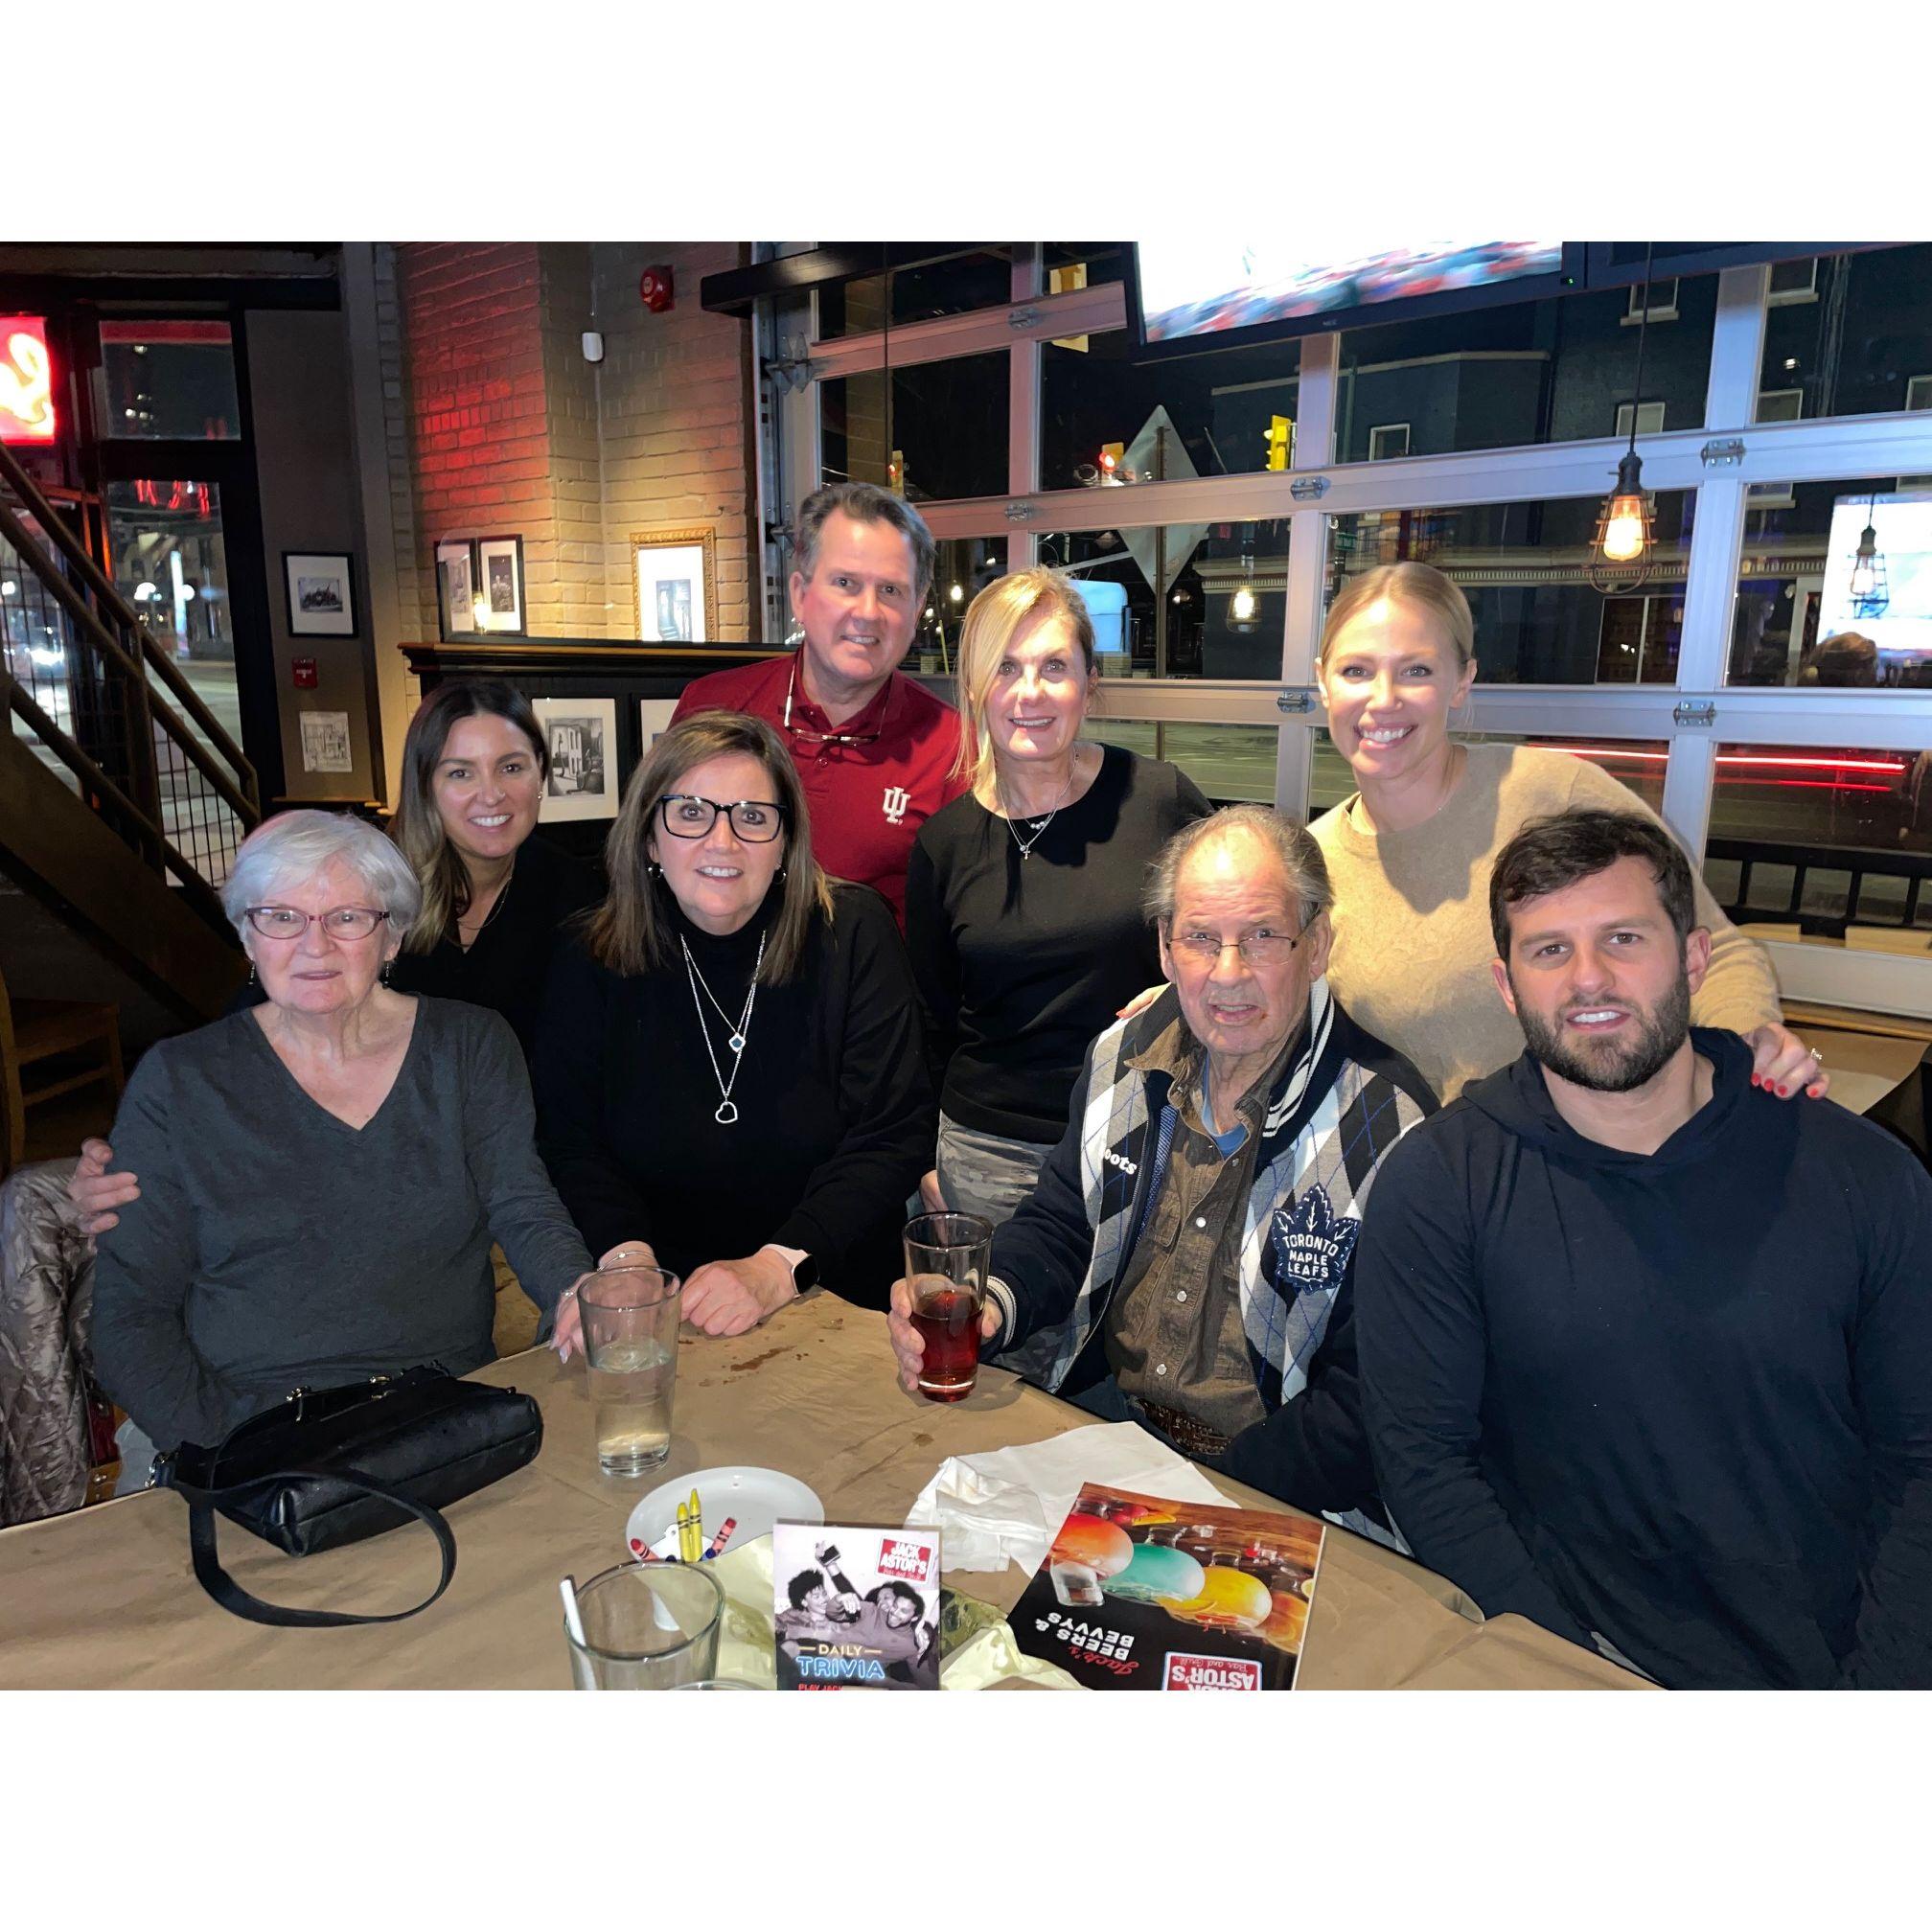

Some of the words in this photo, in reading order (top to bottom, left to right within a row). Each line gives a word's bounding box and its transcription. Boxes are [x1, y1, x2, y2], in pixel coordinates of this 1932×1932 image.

[1282, 1233, 1339, 1256] TORONTO
[1287, 1261, 1329, 1277] LEAFS
[1289, 1250, 1328, 1265] MAPLE
[891, 1541, 921, 1560] JACK
[880, 1552, 928, 1575] ASTOR'S
[1035, 1618, 1050, 1632] &
[1047, 1612, 1135, 1648] BEVVYS
[818, 1644, 862, 1656] DAILY
[1056, 1628, 1130, 1662] BEERS
[795, 1656, 886, 1680] TRIVIA
[1069, 1645, 1140, 1675] Jack's
[1172, 1665, 1255, 1690] ASTOR'S
